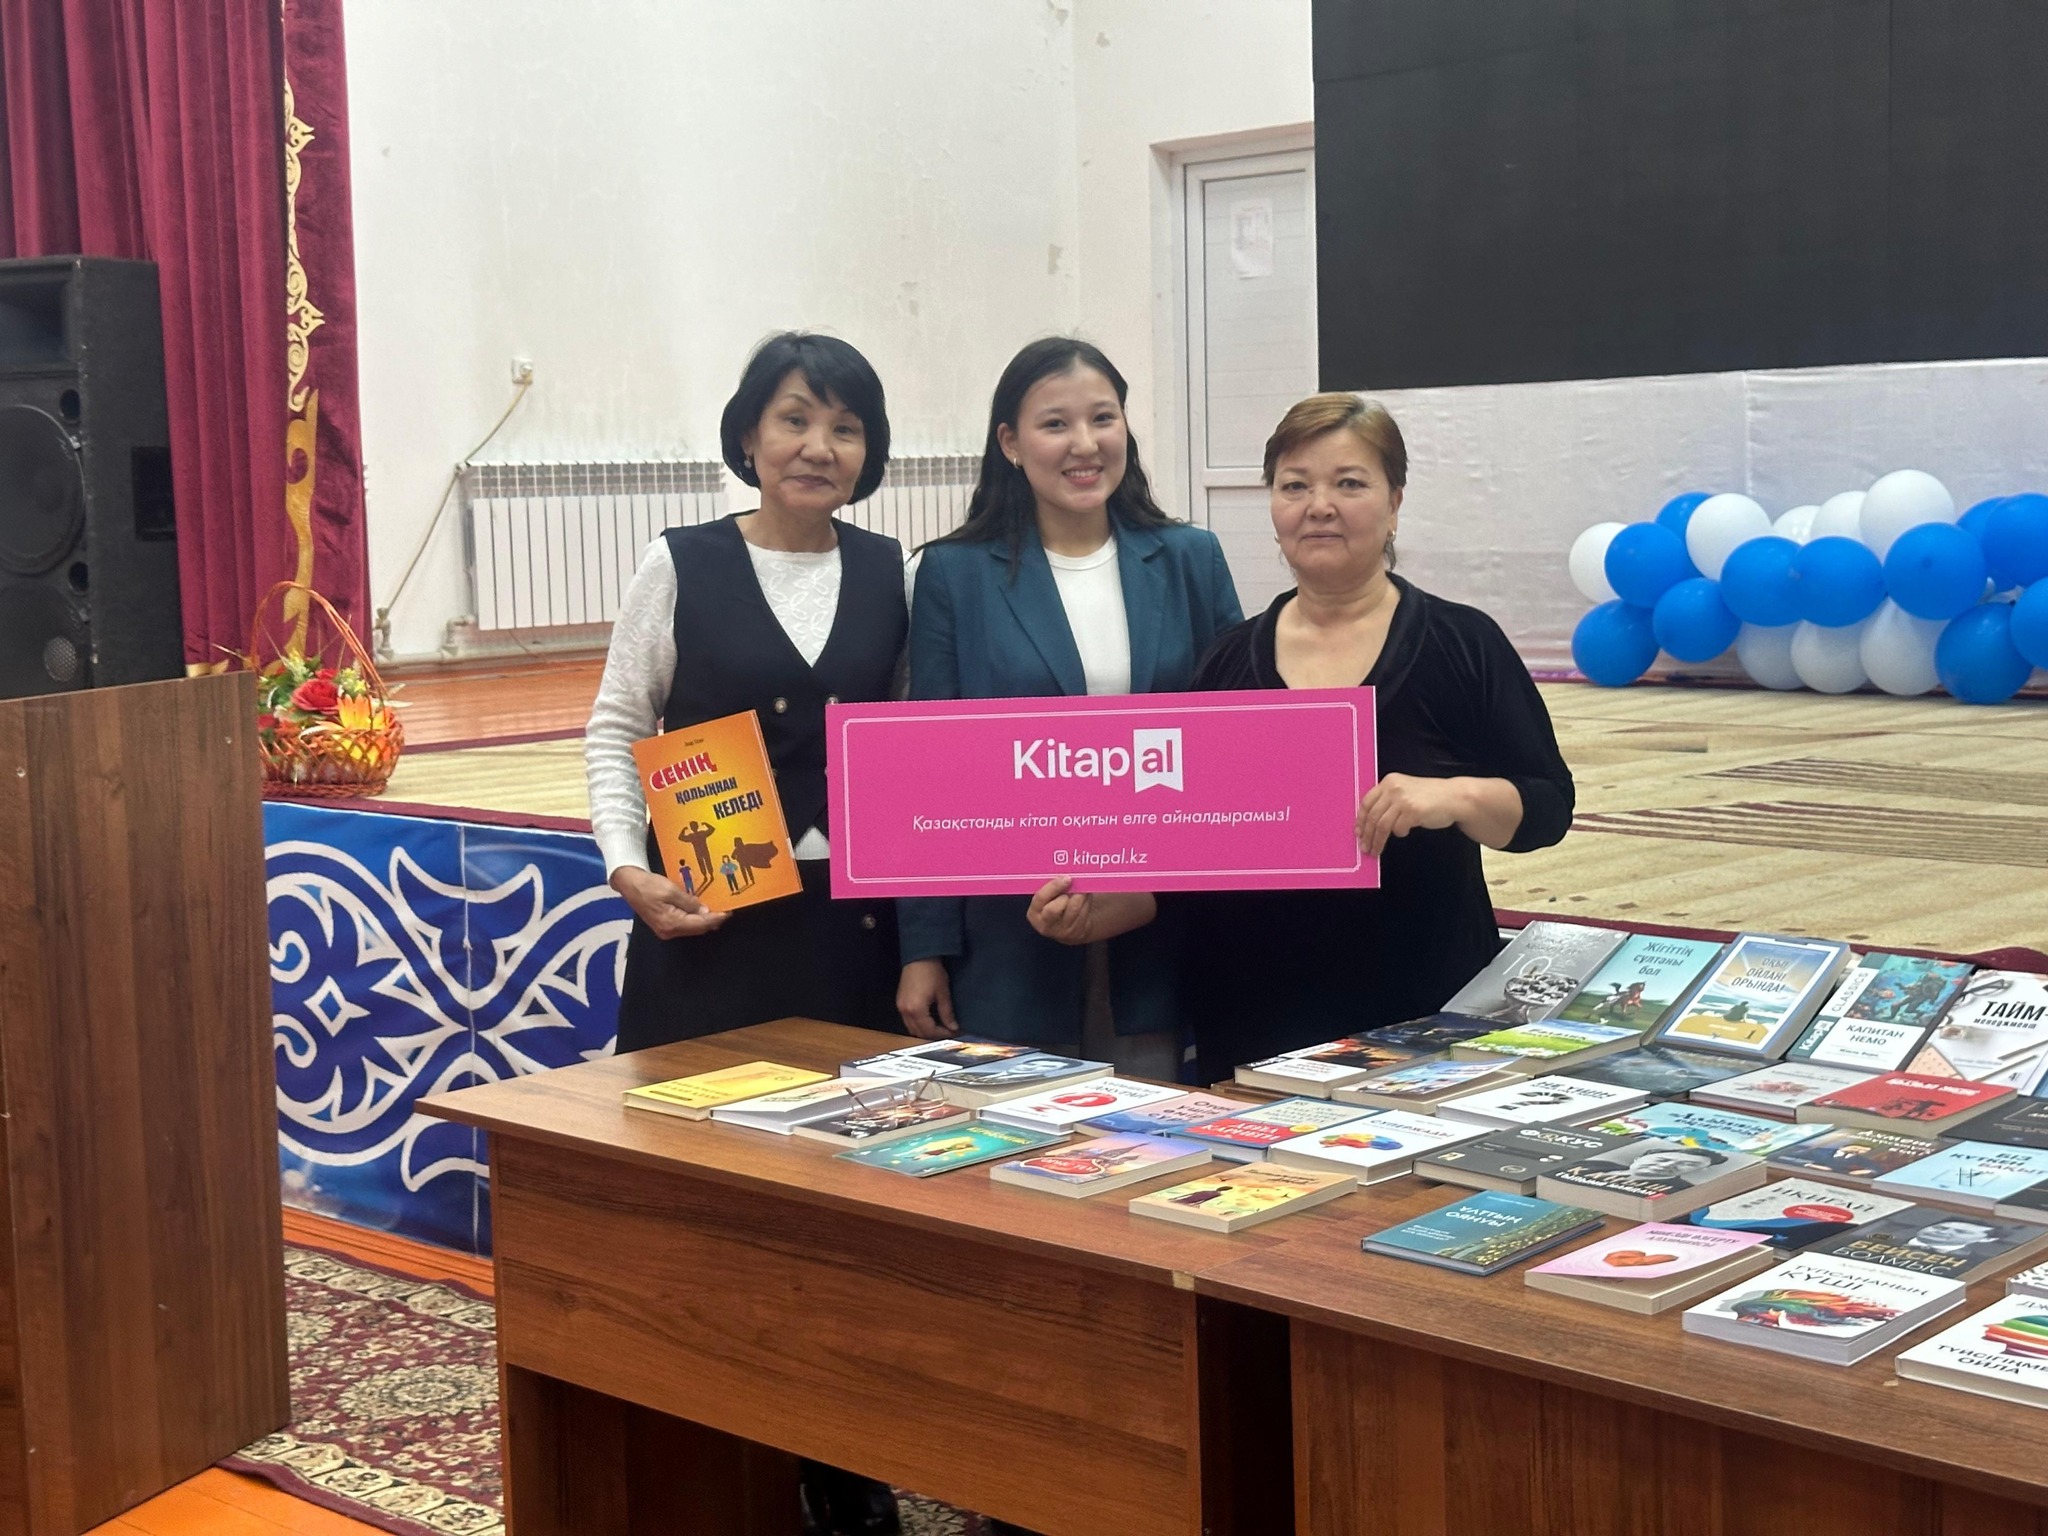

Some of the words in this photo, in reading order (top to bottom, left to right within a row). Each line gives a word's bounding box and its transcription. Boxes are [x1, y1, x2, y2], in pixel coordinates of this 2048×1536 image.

[650, 752, 718, 792] СЕНІҢ
[675, 777, 738, 805] ҚОЛЫҢНАН
[713, 790, 764, 820] КЕЛЕДІ
[912, 815, 1015, 833] Қазақстанды
[1019, 814, 1058, 828] кітап
[1062, 814, 1118, 828] оқитын
[1123, 813, 1157, 825] елге
[1162, 806, 1291, 827] айналдырамыз!
[1072, 847, 1148, 869] kitapal.kz
[1638, 965, 1662, 976] бол
[1746, 968, 1788, 981] ОЙЛАН!
[1731, 977, 1786, 992] ОРЫНДА!
[1831, 972, 1869, 1012] CLASSICS
[1846, 1024, 1905, 1038] КАПИТАН
[1849, 1034, 1887, 1046] НЕМО
[1772, 1187, 1876, 1213] ИКИГАЙ
[1445, 1211, 1506, 1227] ОЯНУЫ
[1832, 1246, 1952, 1275] БОЛМЫС
[1778, 1270, 1866, 1292] КҮШІ
[1957, 1357, 2020, 1374] ОЙЛА
